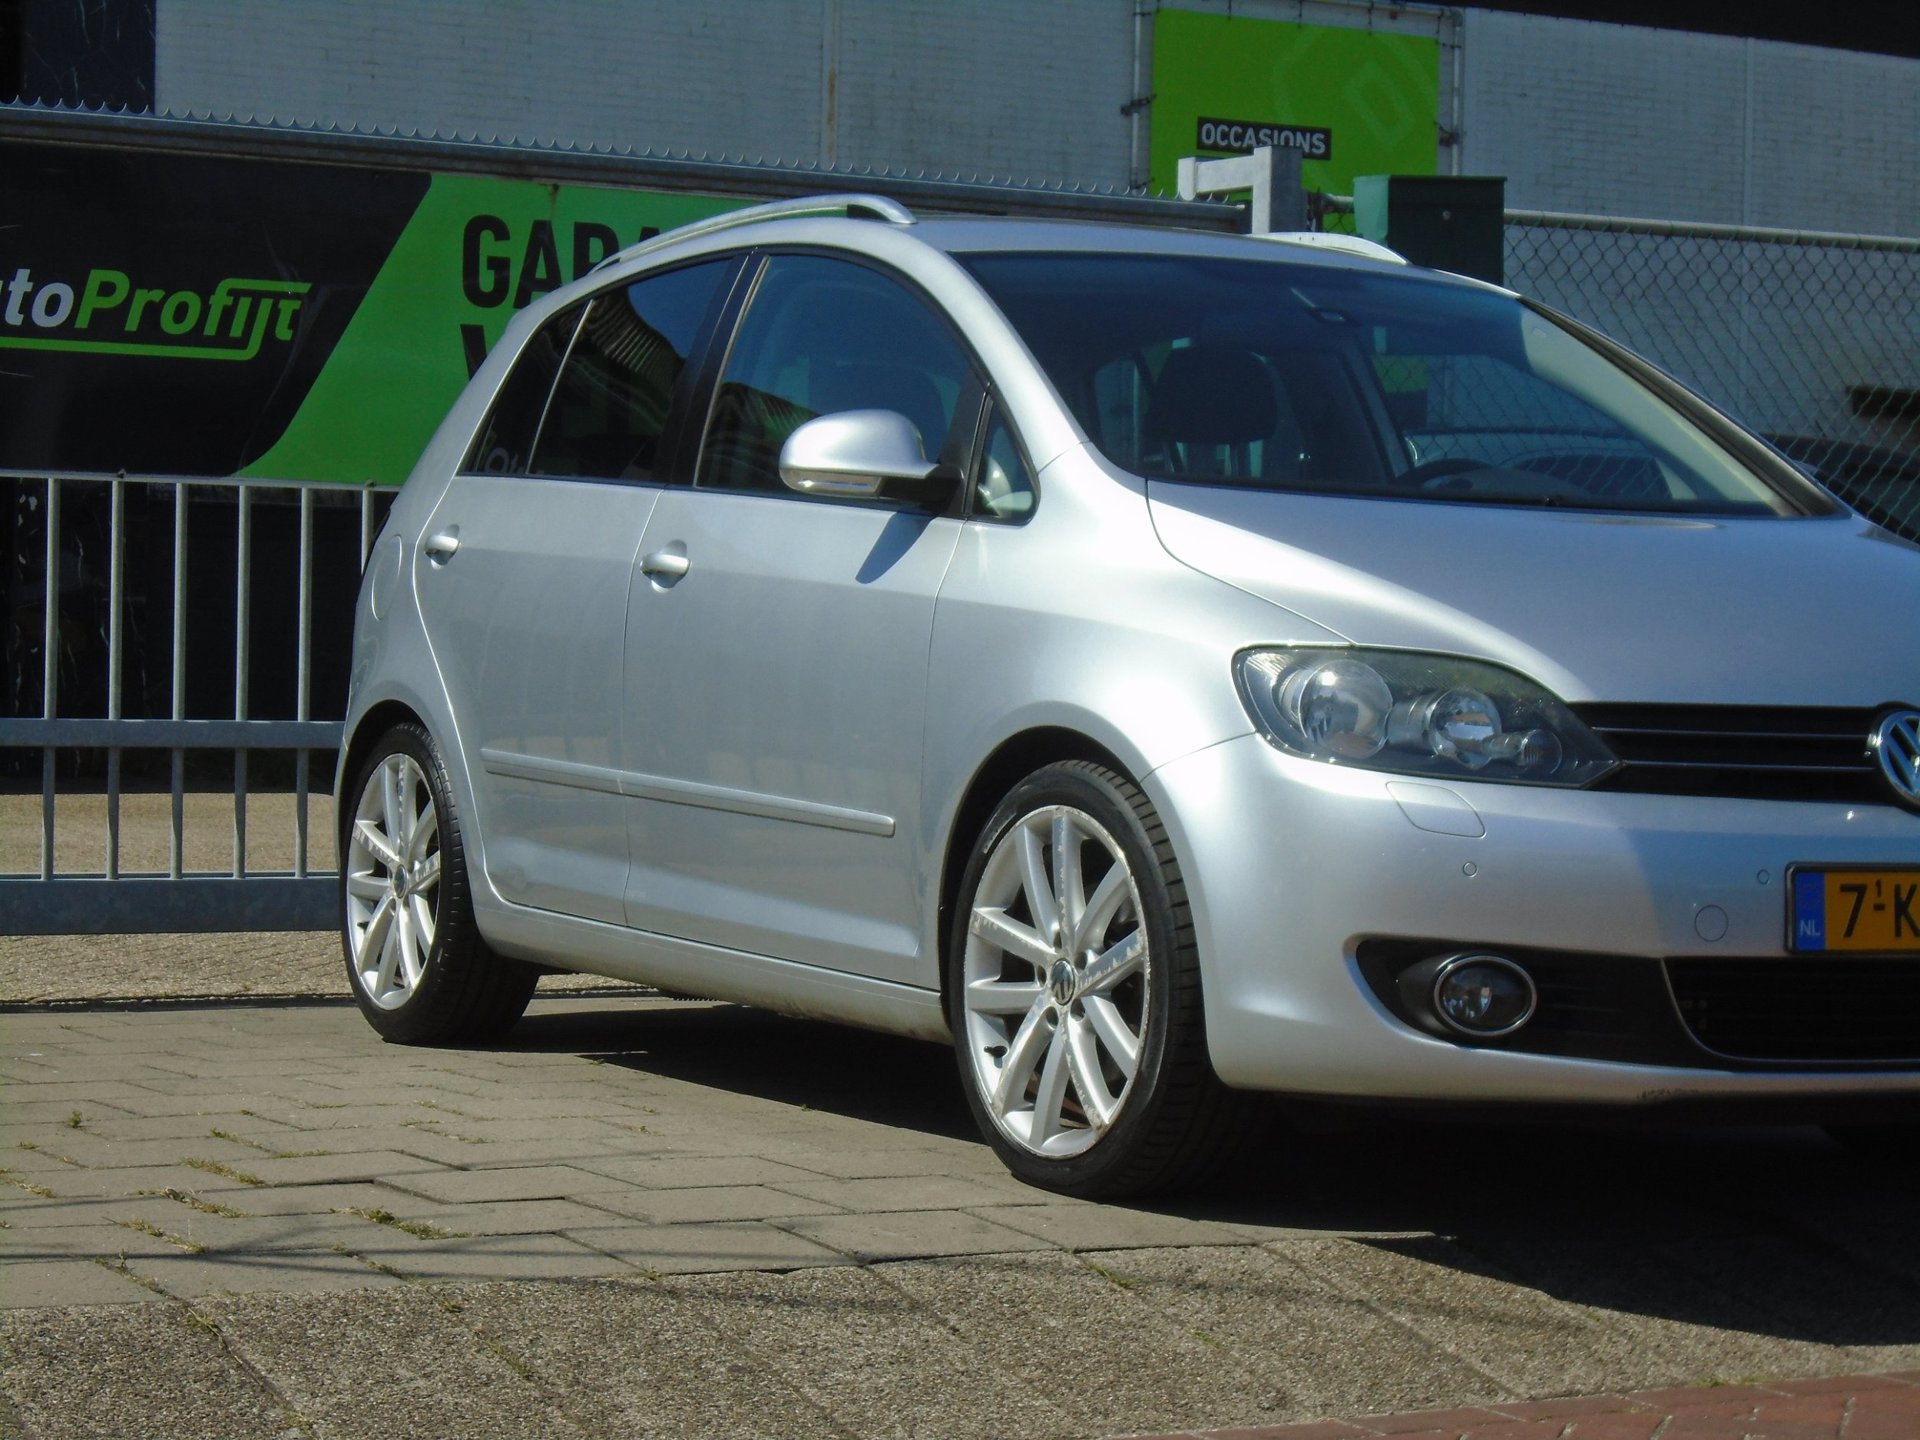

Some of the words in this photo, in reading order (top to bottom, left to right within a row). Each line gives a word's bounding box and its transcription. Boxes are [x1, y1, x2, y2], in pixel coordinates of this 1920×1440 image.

[1201, 122, 1326, 155] OCCASIONS
[0, 268, 312, 361] toProfijt
[1800, 919, 1821, 937] NL
